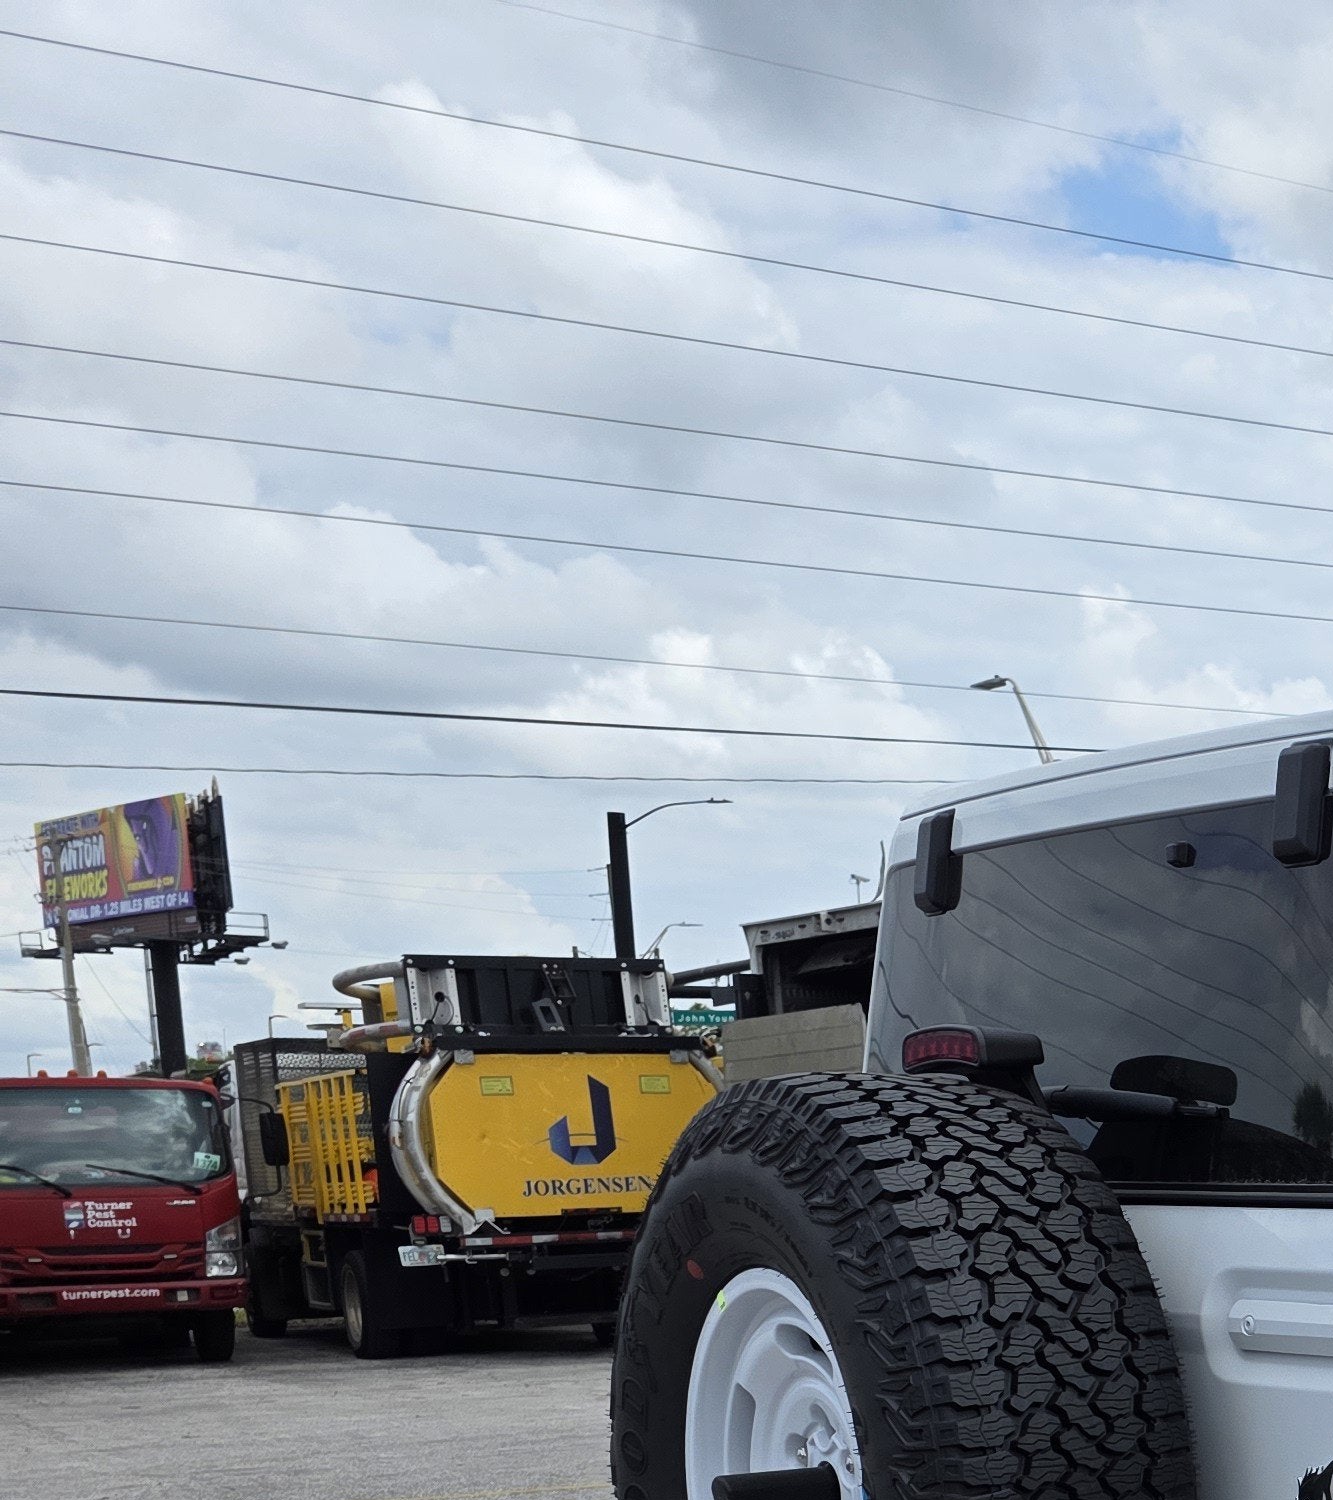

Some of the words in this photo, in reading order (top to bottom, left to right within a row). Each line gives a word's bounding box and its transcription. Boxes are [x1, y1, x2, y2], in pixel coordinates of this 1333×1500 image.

[42, 832, 106, 877] PANTOM
[46, 868, 108, 901] FIEWORKS
[144, 894, 165, 911] WEST
[677, 1013, 706, 1023] John
[522, 1174, 654, 1198] JORGENSEN
[84, 1201, 134, 1210] Turner
[86, 1209, 116, 1219] Pest
[87, 1217, 138, 1228] Control
[61, 1287, 161, 1301] turnerpest.com
